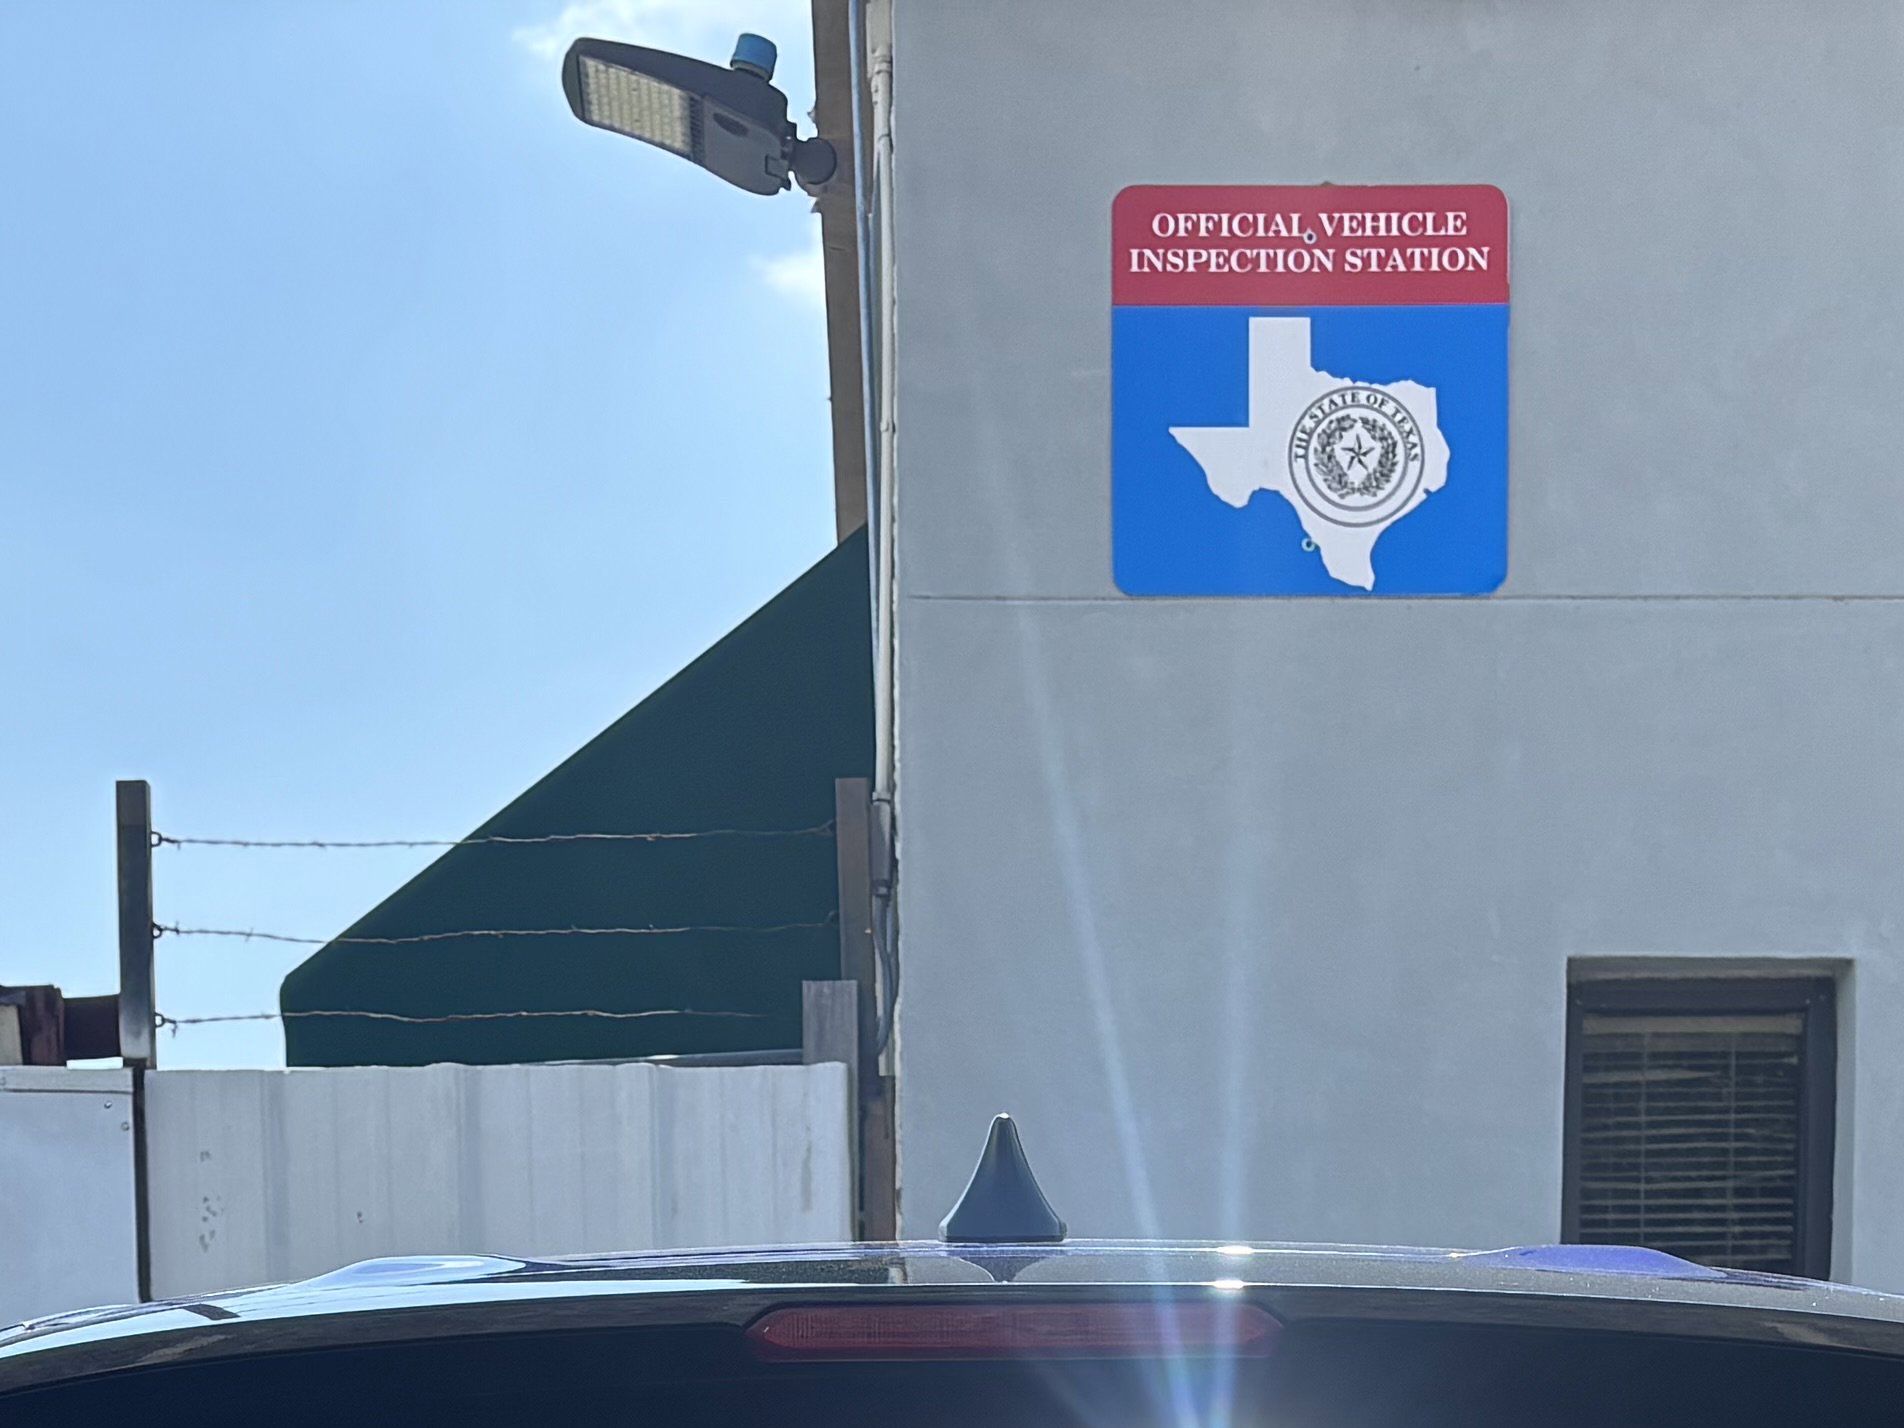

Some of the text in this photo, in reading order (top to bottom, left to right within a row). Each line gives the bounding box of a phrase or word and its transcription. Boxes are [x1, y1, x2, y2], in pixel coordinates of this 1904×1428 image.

[1151, 211, 1468, 239] OFFICIAL VEHICLE
[1129, 246, 1490, 273] INSPECTION STATION
[1294, 391, 1421, 463] THE STATE OF TEXAS
